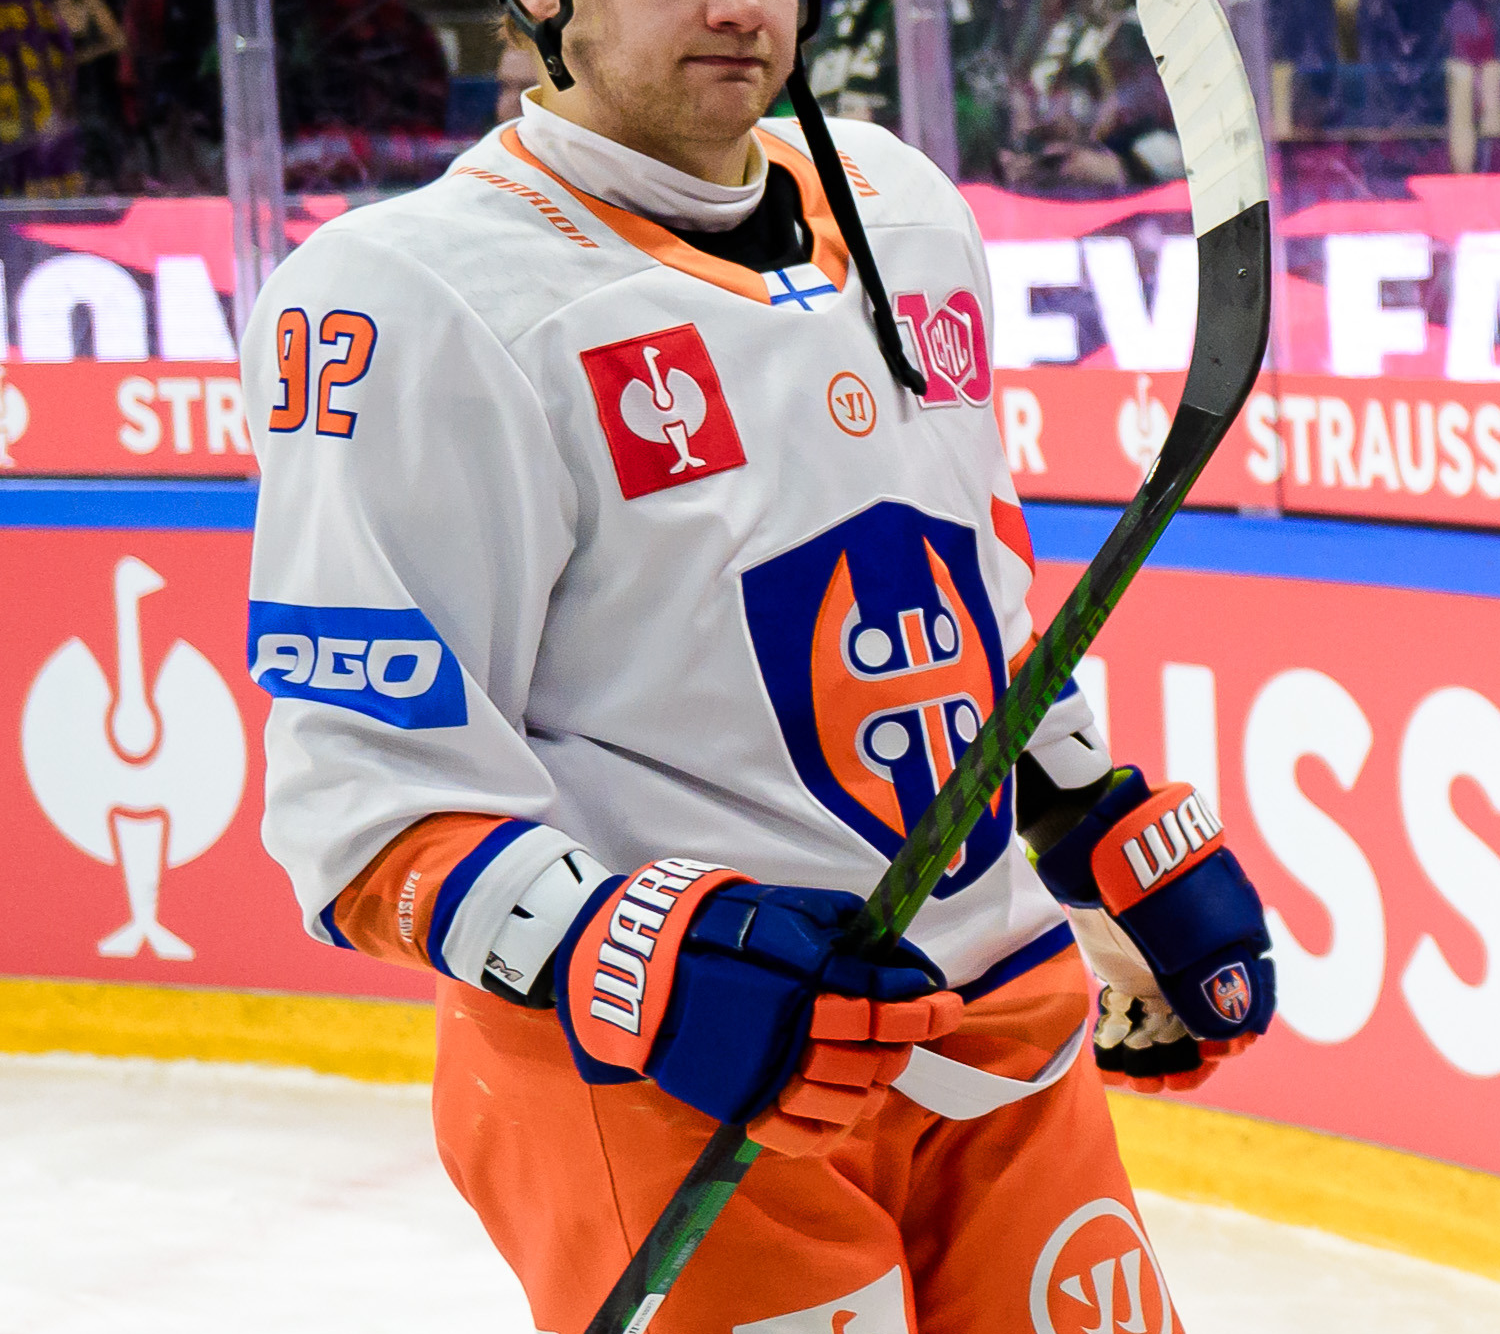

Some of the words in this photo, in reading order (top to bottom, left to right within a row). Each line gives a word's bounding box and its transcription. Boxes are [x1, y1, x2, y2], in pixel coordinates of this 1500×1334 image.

[452, 165, 600, 249] WARRIOR
[268, 307, 378, 440] 92
[930, 317, 970, 378] CHL
